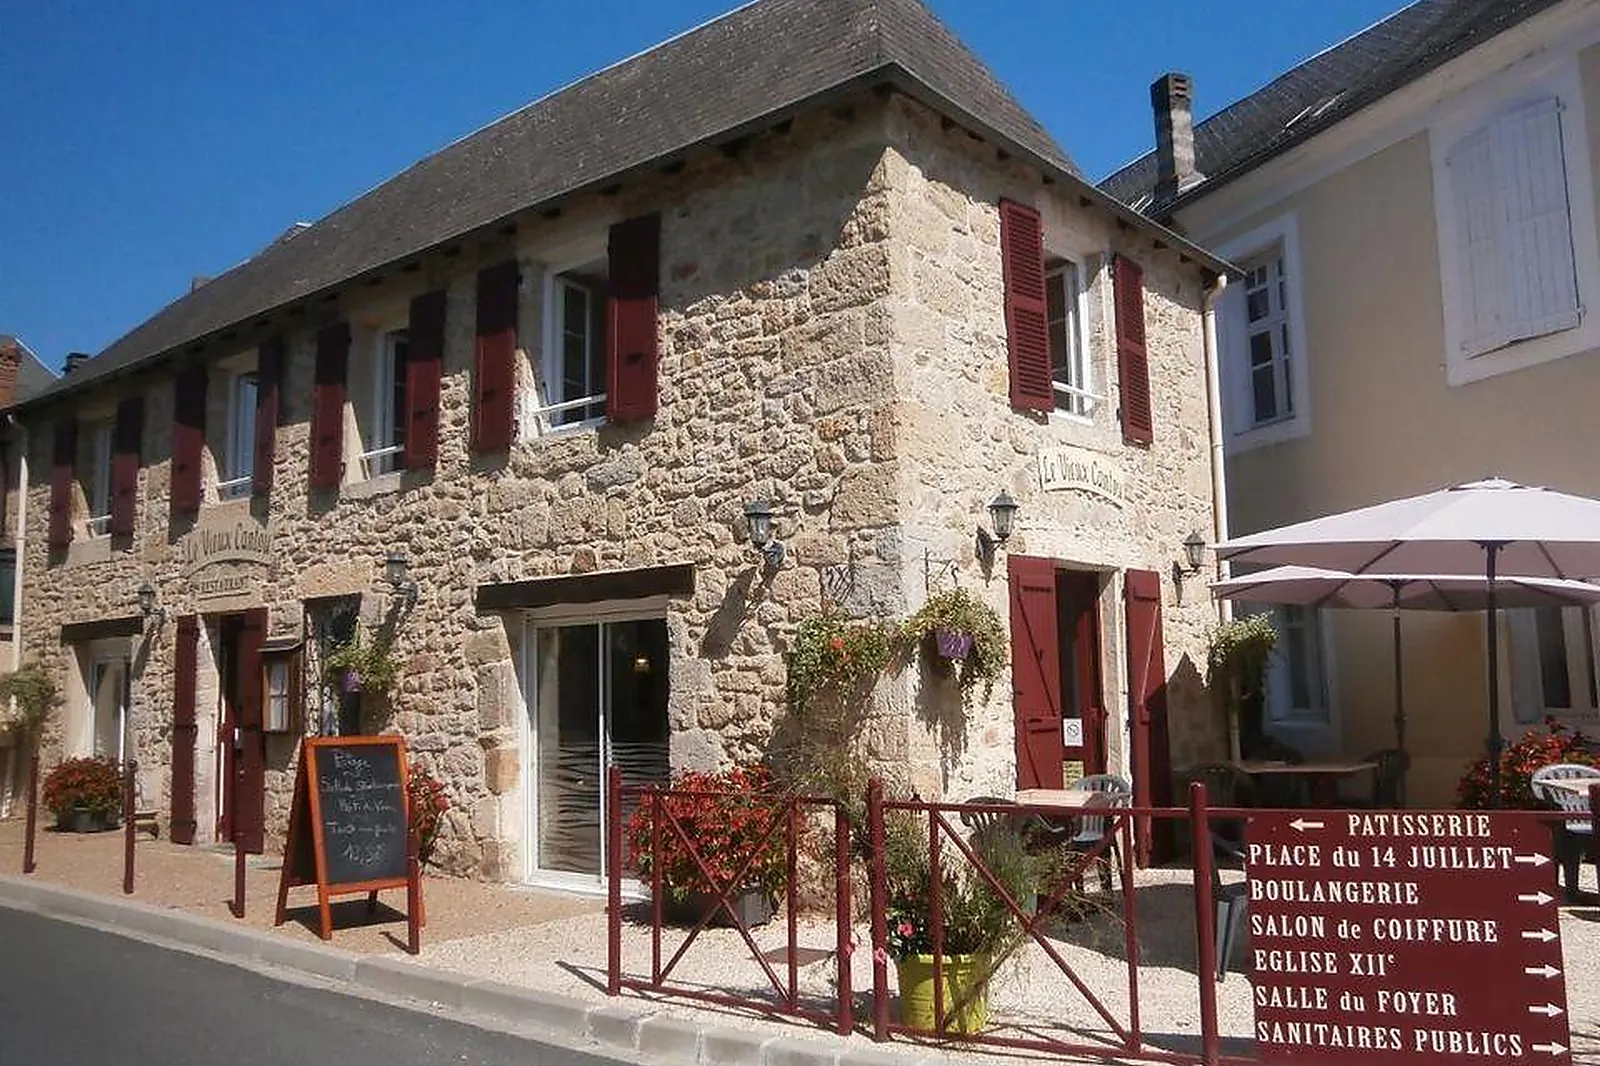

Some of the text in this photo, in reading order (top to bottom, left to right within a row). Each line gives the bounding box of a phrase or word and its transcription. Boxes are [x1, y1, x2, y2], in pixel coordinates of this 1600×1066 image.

[1043, 455, 1056, 483] Le
[1057, 453, 1089, 483] Vieux
[186, 536, 199, 564] Le
[201, 528, 231, 556] Vieux
[1347, 814, 1491, 838] PATISSERIE
[1249, 843, 1513, 870] PLACE du 14 JUILLET
[1250, 879, 1419, 905] BOULANGERIE
[1251, 914, 1498, 943] SALON de COIFFURE
[1254, 949, 1338, 974] EGLISE
[1255, 985, 1457, 1016] SALLE du FOYER
[1256, 1020, 1523, 1057] SANITAIRES PUBLICS
